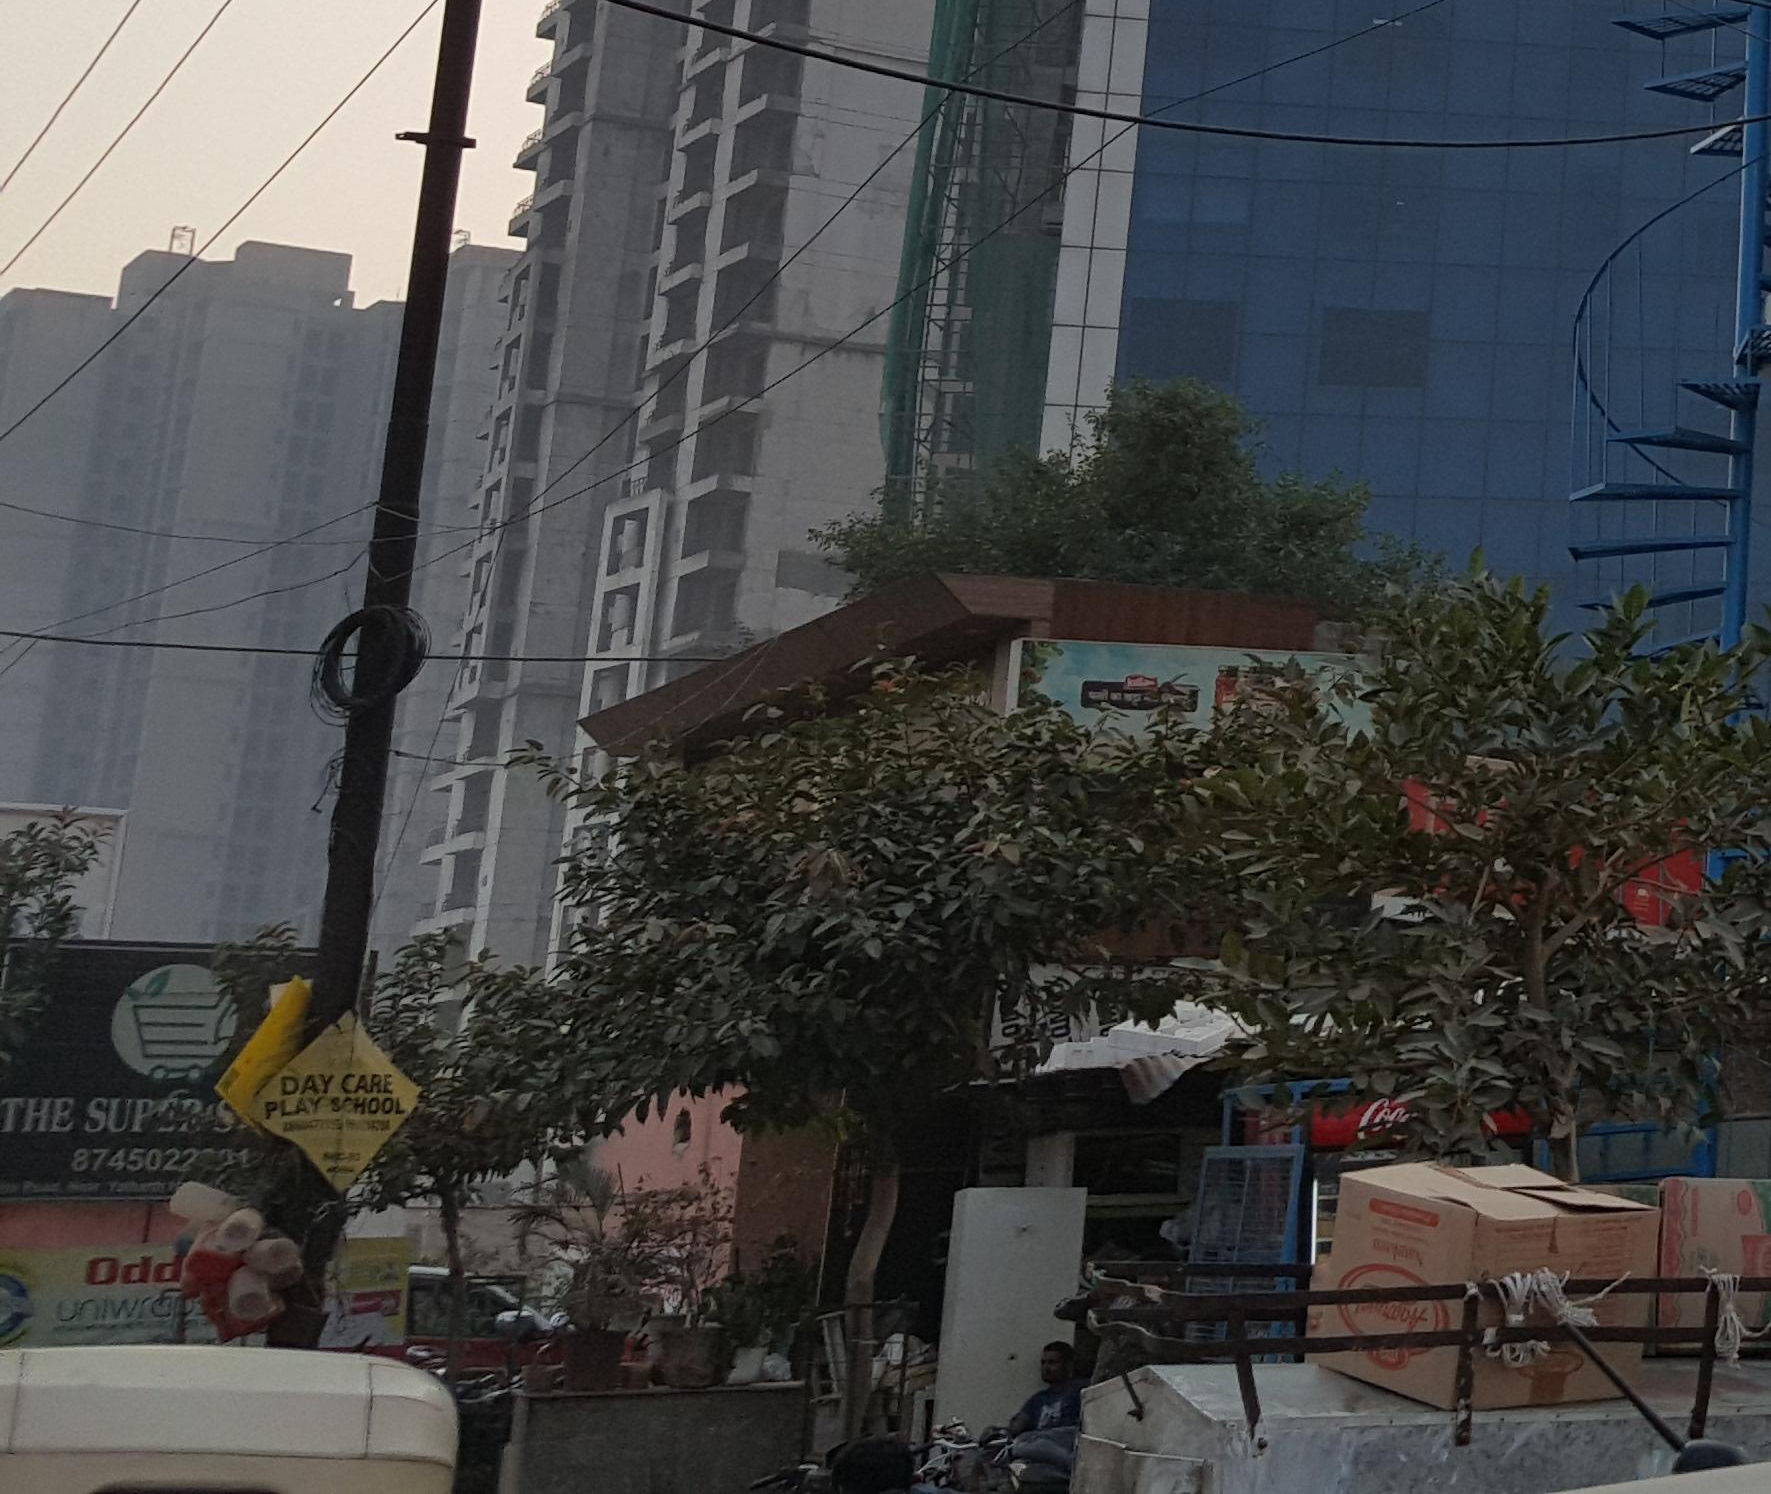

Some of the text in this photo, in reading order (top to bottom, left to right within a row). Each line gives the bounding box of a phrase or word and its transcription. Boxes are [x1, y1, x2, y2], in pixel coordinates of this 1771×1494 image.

[280, 1073, 393, 1096] DAY CARE
[0, 1096, 76, 1133] THE
[265, 1097, 321, 1120] PLAY
[331, 1097, 406, 1115] SCHOOL
